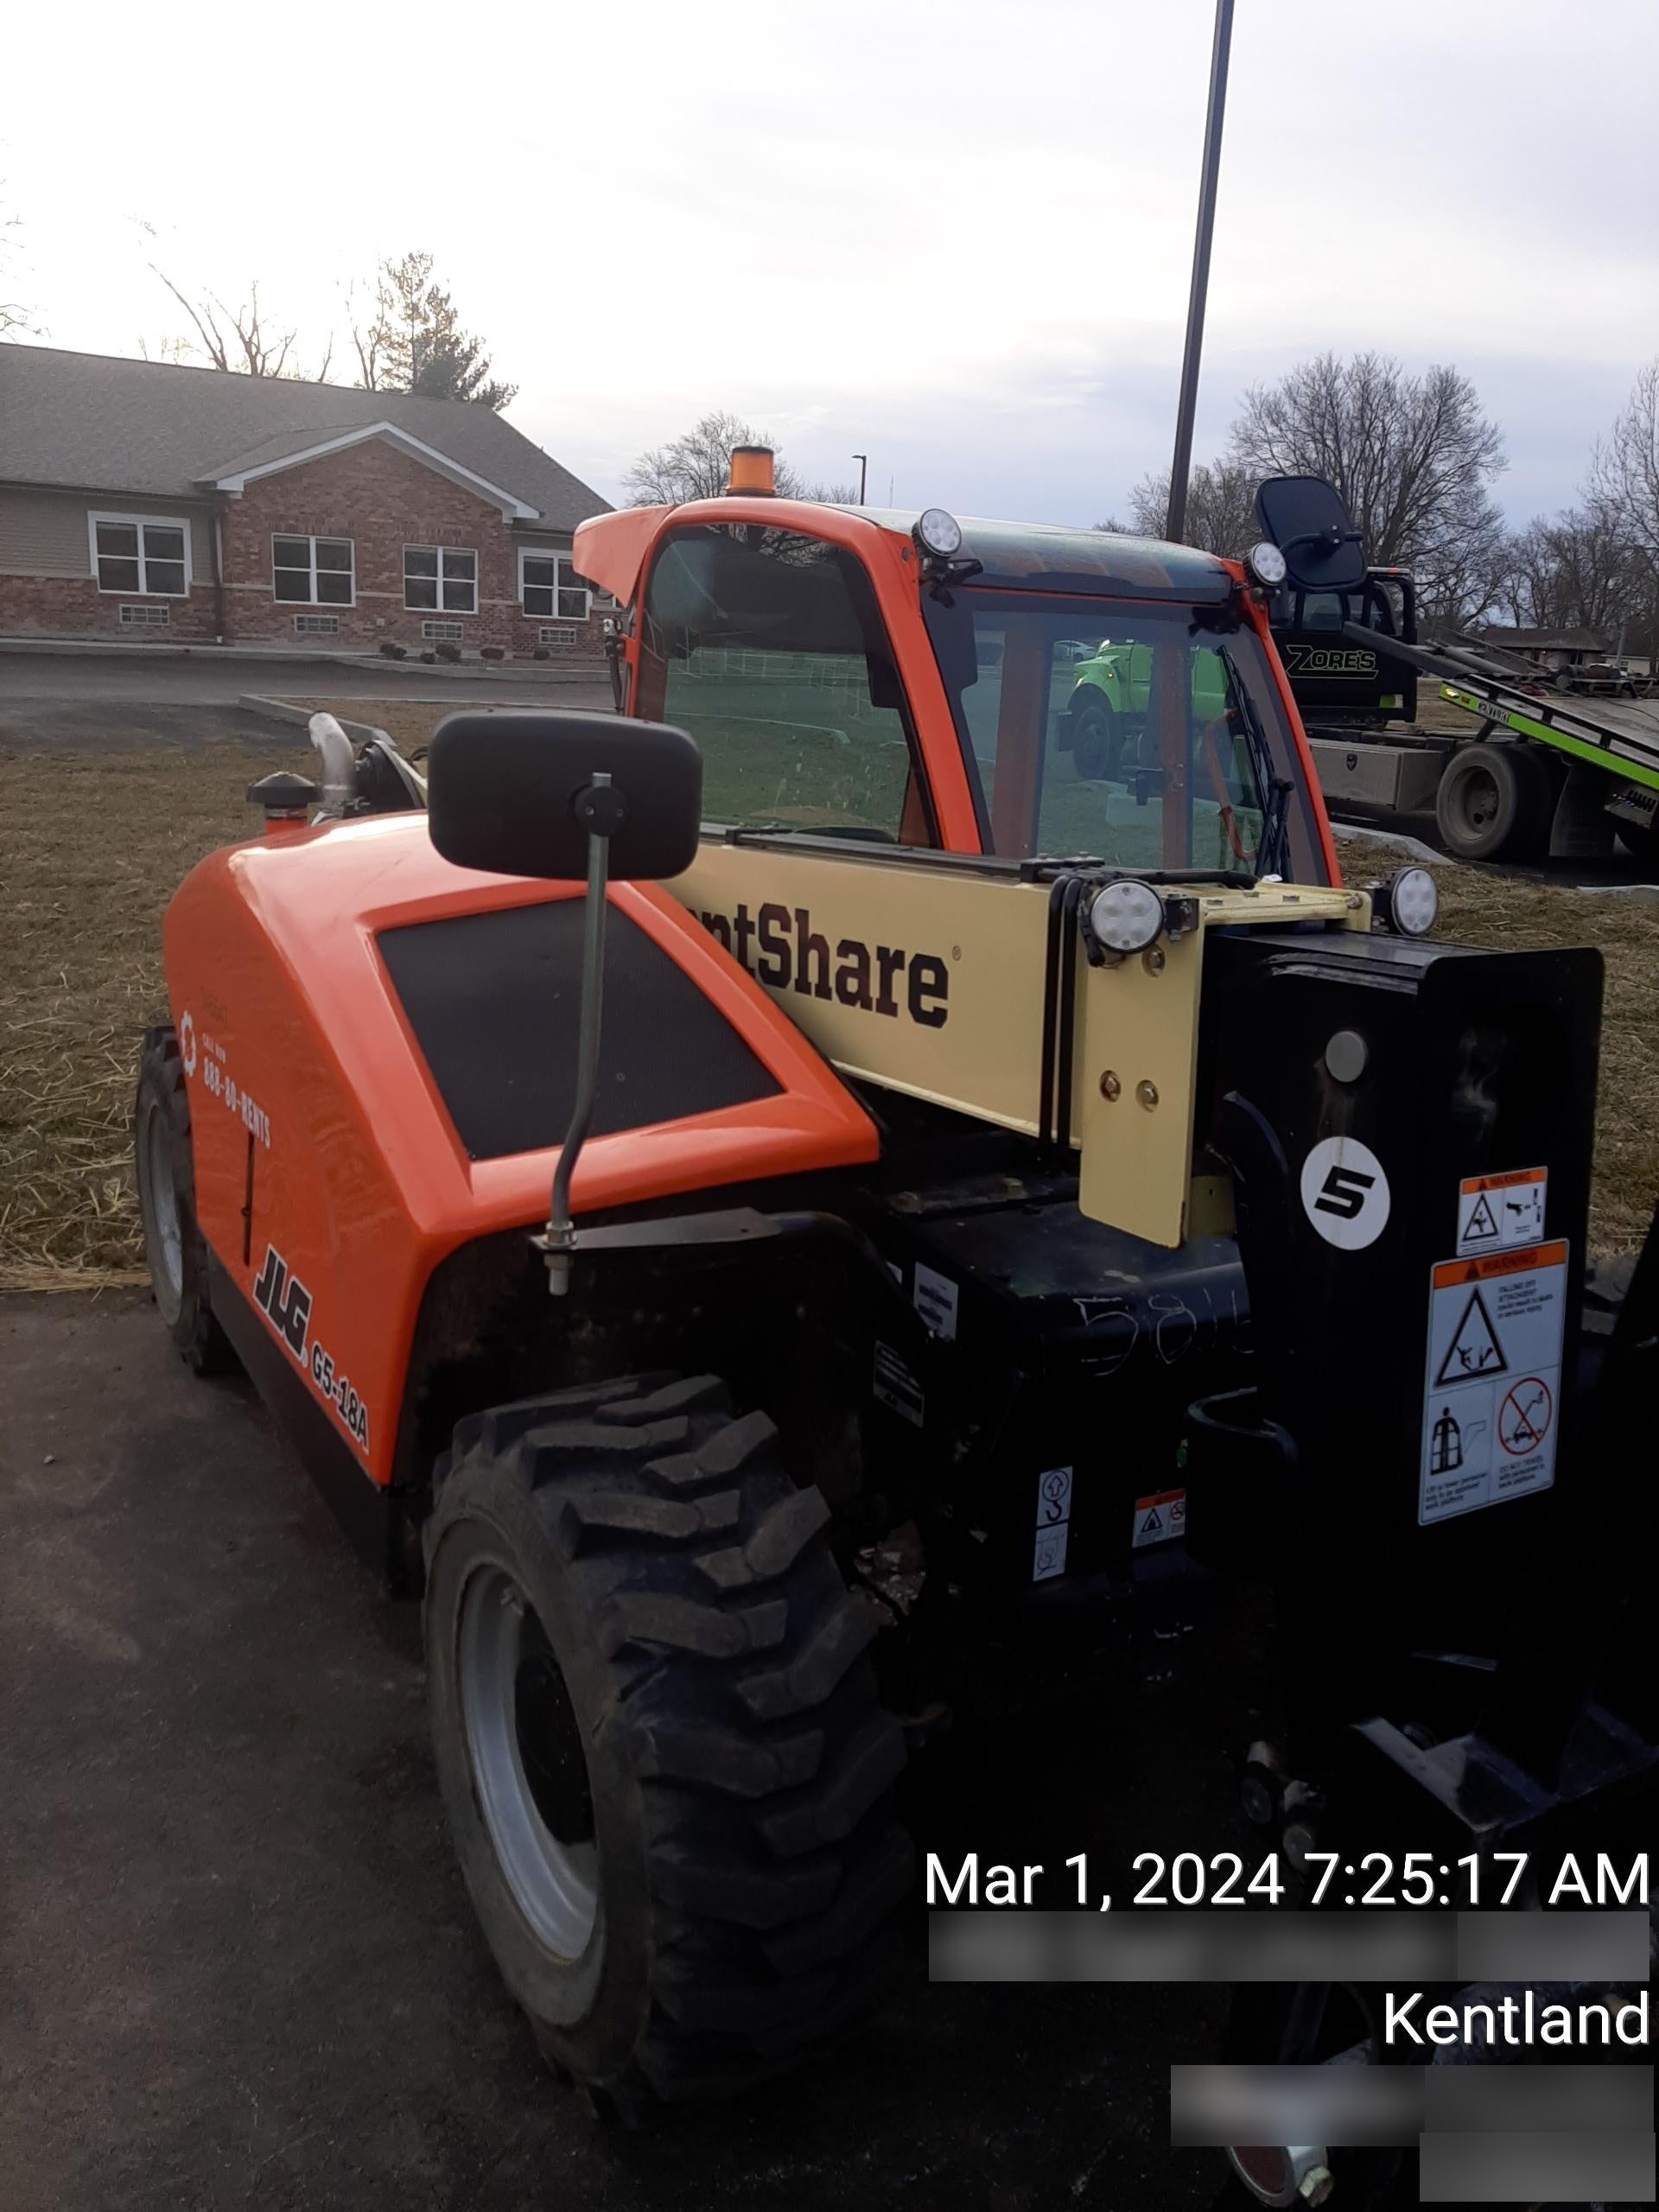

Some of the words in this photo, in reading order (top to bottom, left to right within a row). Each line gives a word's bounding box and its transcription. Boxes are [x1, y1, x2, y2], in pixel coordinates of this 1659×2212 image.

[1286, 645, 1378, 677] ZORE'S
[686, 903, 950, 1029] ntShare
[203, 1056, 271, 1150] 888-80-RENTS
[253, 1244, 312, 1360] JLG
[1482, 1249, 1538, 1274] WARNING
[313, 1342, 369, 1454] G5-18A
